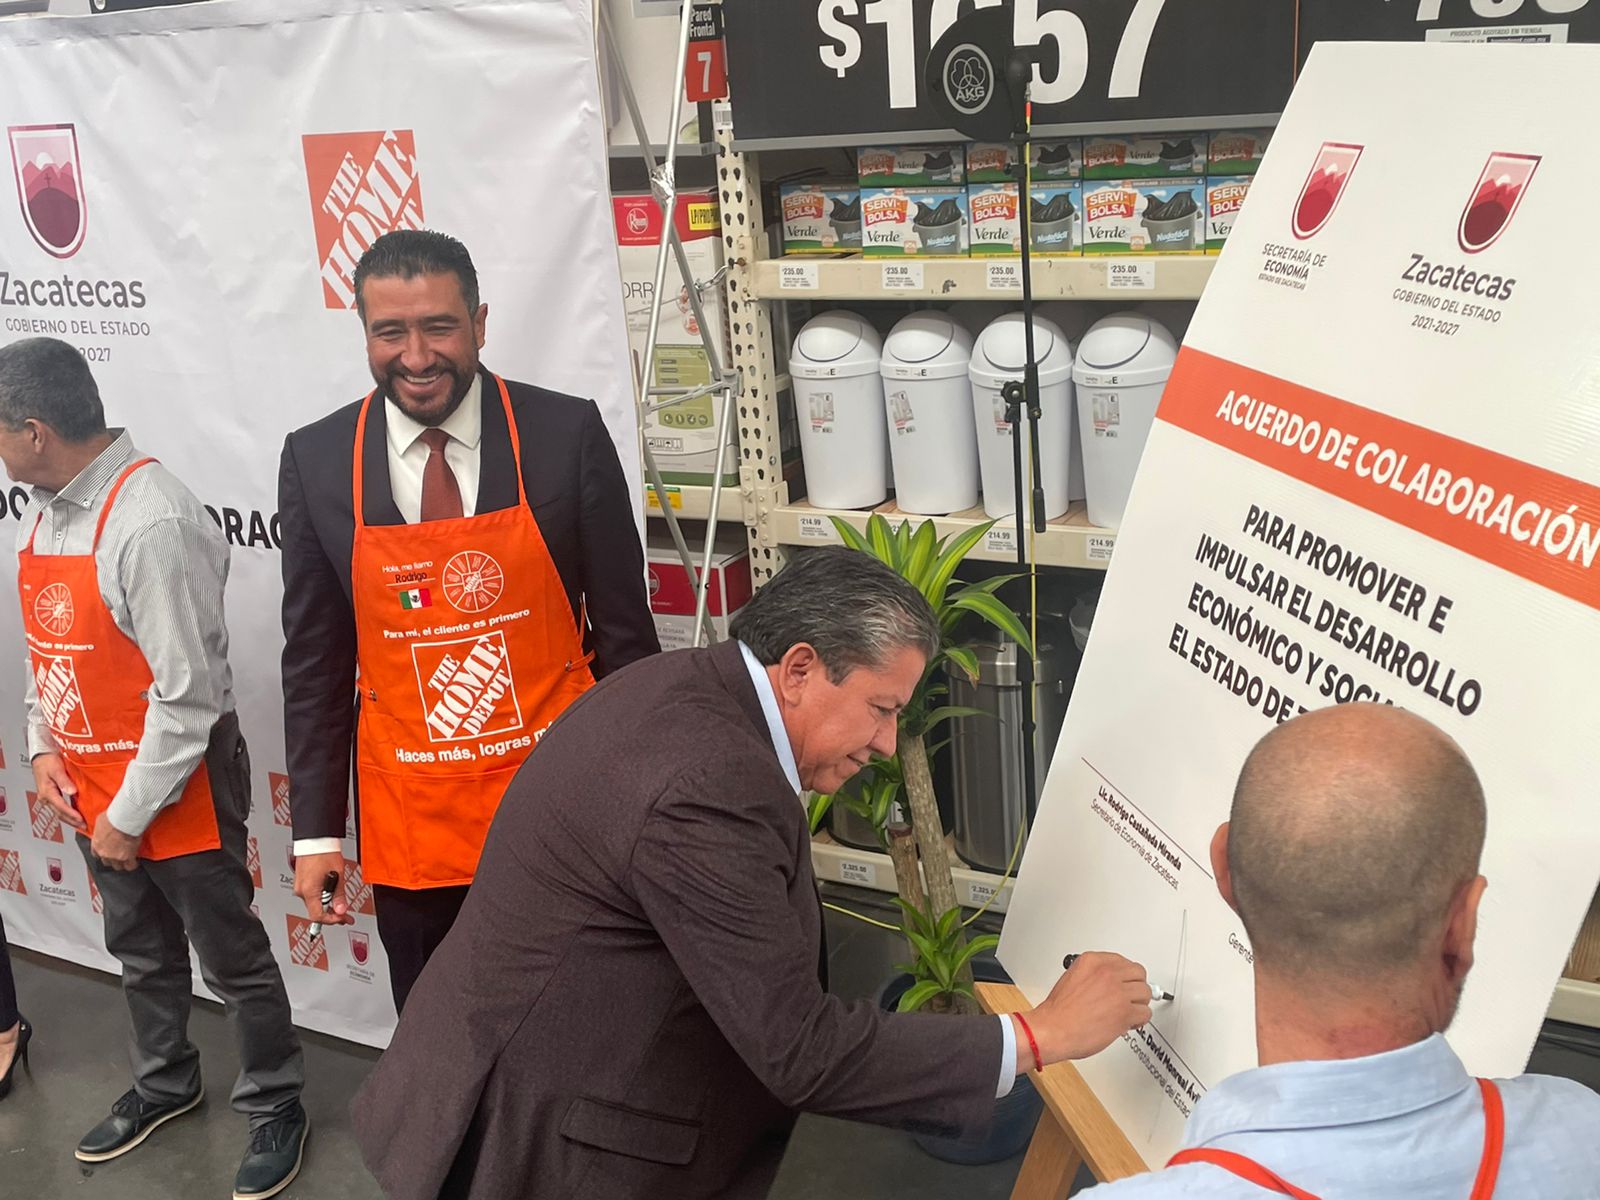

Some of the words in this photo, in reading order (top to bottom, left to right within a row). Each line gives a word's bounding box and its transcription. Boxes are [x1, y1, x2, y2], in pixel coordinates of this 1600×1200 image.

[690, 7, 712, 22] Pared
[689, 22, 716, 38] Frontal
[697, 51, 712, 93] 7
[956, 86, 985, 101] AKG
[321, 151, 364, 224] THE
[1213, 186, 1248, 200] SERV
[320, 130, 417, 310] HOME
[786, 206, 817, 219] BOLSA
[867, 210, 900, 223] BOLSA
[975, 206, 1009, 221] BOLSA
[1090, 204, 1127, 219] BOLSA
[1213, 199, 1244, 214] BOLS
[787, 225, 818, 237] Verde
[867, 230, 900, 243] Verde
[974, 227, 1009, 240] Verde
[1089, 225, 1126, 239] Verde
[1211, 221, 1233, 235] Ver
[1262, 242, 1313, 263] SECRETARÍA
[1312, 253, 1328, 267] DE
[1263, 259, 1310, 280] ECONOMÍA
[1401, 252, 1517, 301] Zacatecas
[0, 271, 147, 309] Zacatecas
[1393, 288, 1441, 310] GOBIERNO
[1440, 298, 1460, 315] DEL
[1461, 303, 1502, 323] ESTADO
[5, 317, 68, 335] GOBIERNO
[71, 320, 98, 335] DEL
[100, 320, 151, 337] ESTADO
[1411, 314, 1460, 337] 2021-2027
[1215, 389, 1322, 455] ACUERDO
[1317, 426, 1360, 471] DE
[1354, 441, 1600, 569] COLABORACIÓN
[395, 572, 428, 583] Rodrigo
[1242, 503, 1296, 556] PARA
[1294, 529, 1427, 622] PROMOVER
[1427, 594, 1454, 634] E
[383, 629, 404, 639] Para
[422, 627, 432, 636] el
[433, 622, 470, 636] cliente
[473, 620, 486, 630] es
[489, 608, 530, 627] primero
[1187, 581, 1303, 675] ECONÓMICO
[1305, 650, 1323, 686] Y
[1195, 532, 1290, 610] IMPULSAR
[1286, 583, 1314, 625] EL
[1314, 598, 1482, 717] DESARROLLO
[427, 653, 461, 694] THE
[1168, 622, 1189, 660] EL
[1189, 636, 1264, 707] ESTADO
[1262, 686, 1295, 726] DE
[40, 655, 74, 727] HOME
[426, 636, 506, 739] HOME
[462, 668, 513, 736] DEPOT
[395, 747, 435, 763] Haces
[438, 745, 476, 761] más,
[479, 733, 532, 757] logras
[1091, 798, 1115, 828] Secretario
[1113, 822, 1121, 834] de
[1144, 851, 1153, 864] de
[1108, 794, 1129, 821] Rodrigo
[1128, 813, 1158, 849] Castañeda
[1157, 840, 1182, 871] Miranda
[40, 883, 76, 897] Zacatecas
[1146, 1034, 1165, 1061] David
[1162, 1054, 1189, 1091] Monreal
